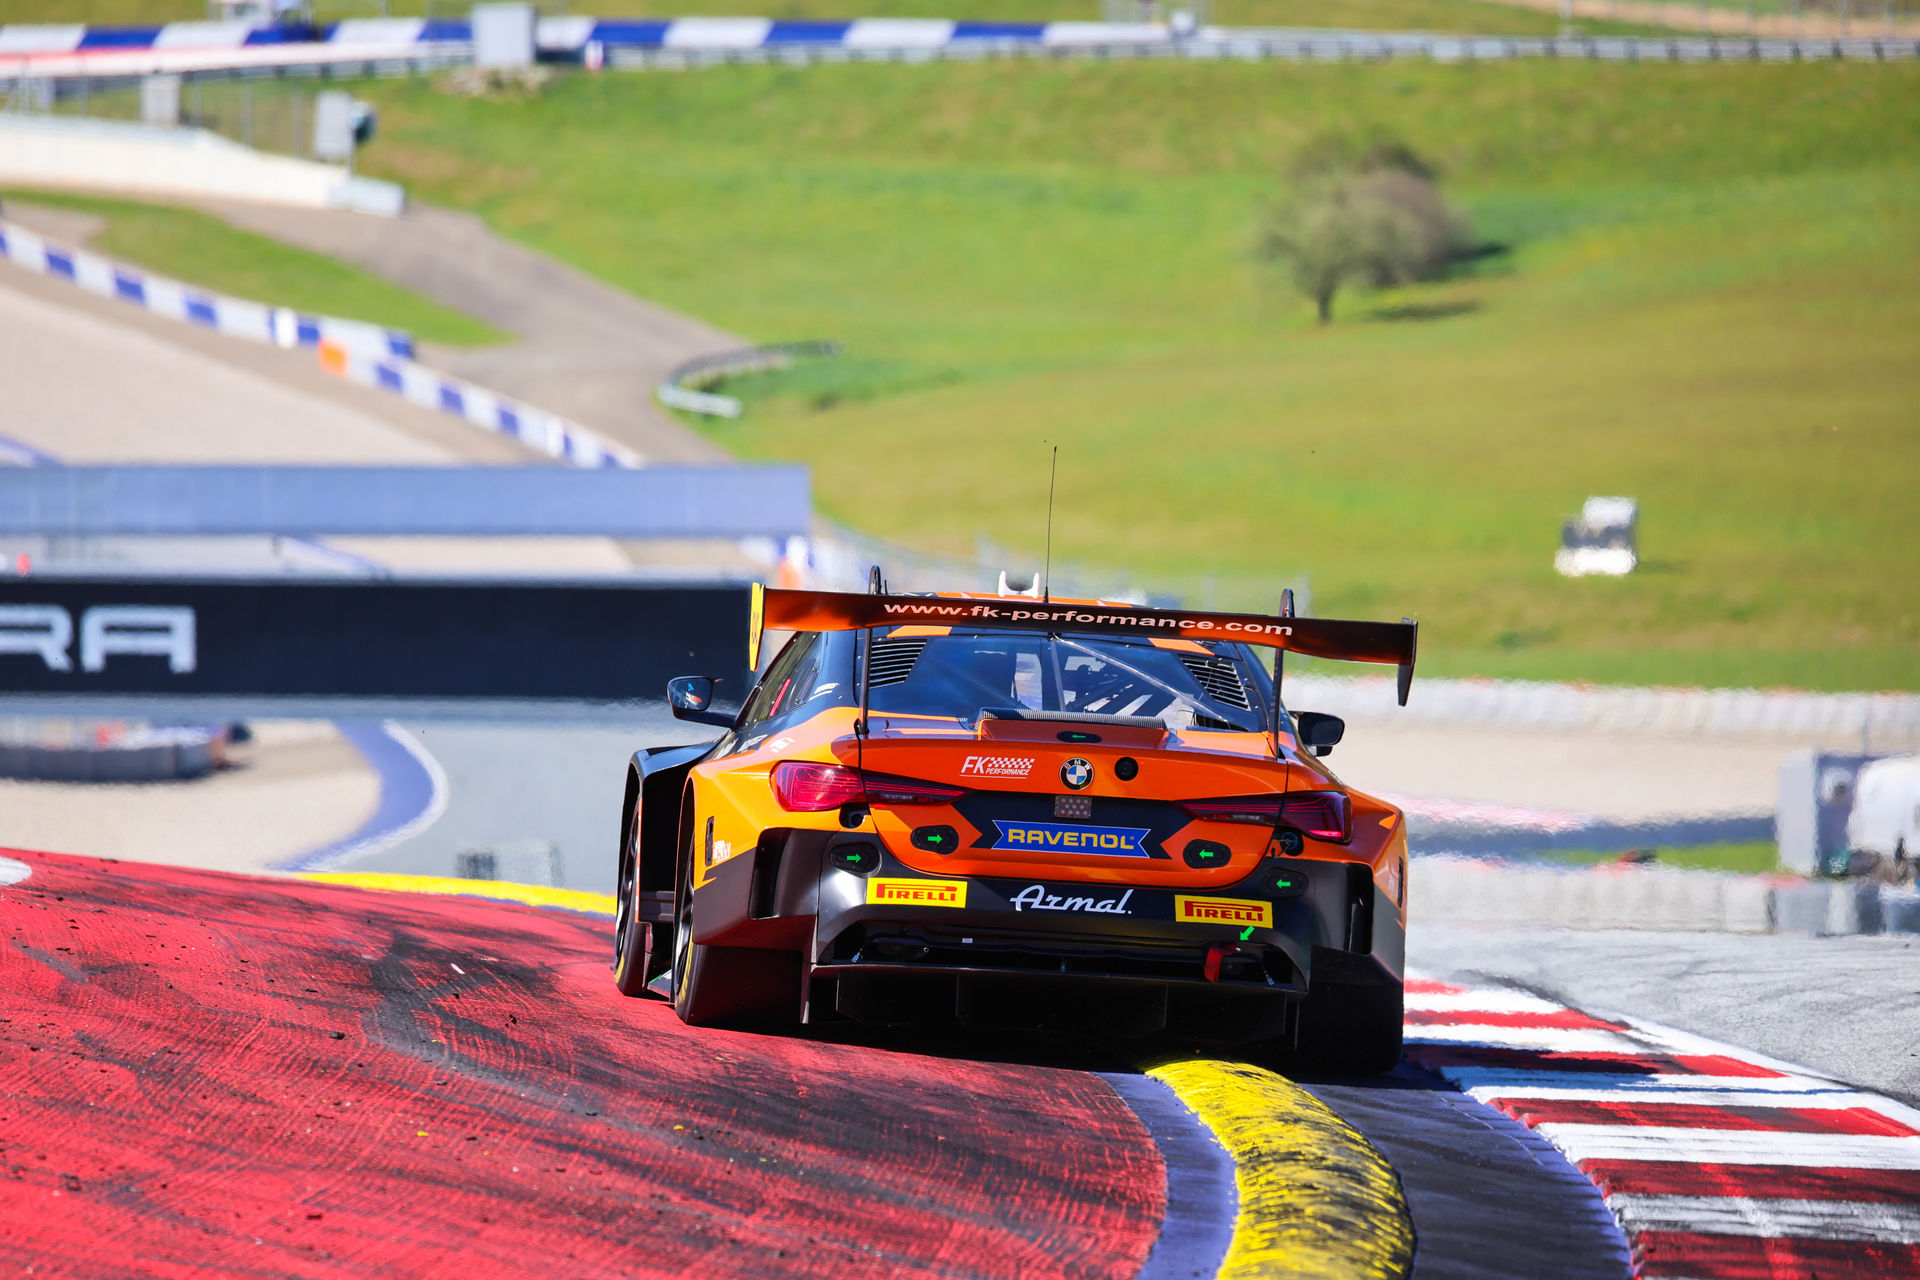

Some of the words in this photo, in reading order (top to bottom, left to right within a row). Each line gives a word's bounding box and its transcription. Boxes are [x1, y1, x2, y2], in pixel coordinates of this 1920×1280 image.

[884, 603, 1294, 636] www.fk-performance.com
[961, 755, 990, 774] FK
[985, 767, 1031, 776] PERFORMANCE
[1008, 829, 1135, 850] RAVENOL
[876, 883, 958, 902] PIRELLI
[1184, 900, 1264, 922] PIRELLI
